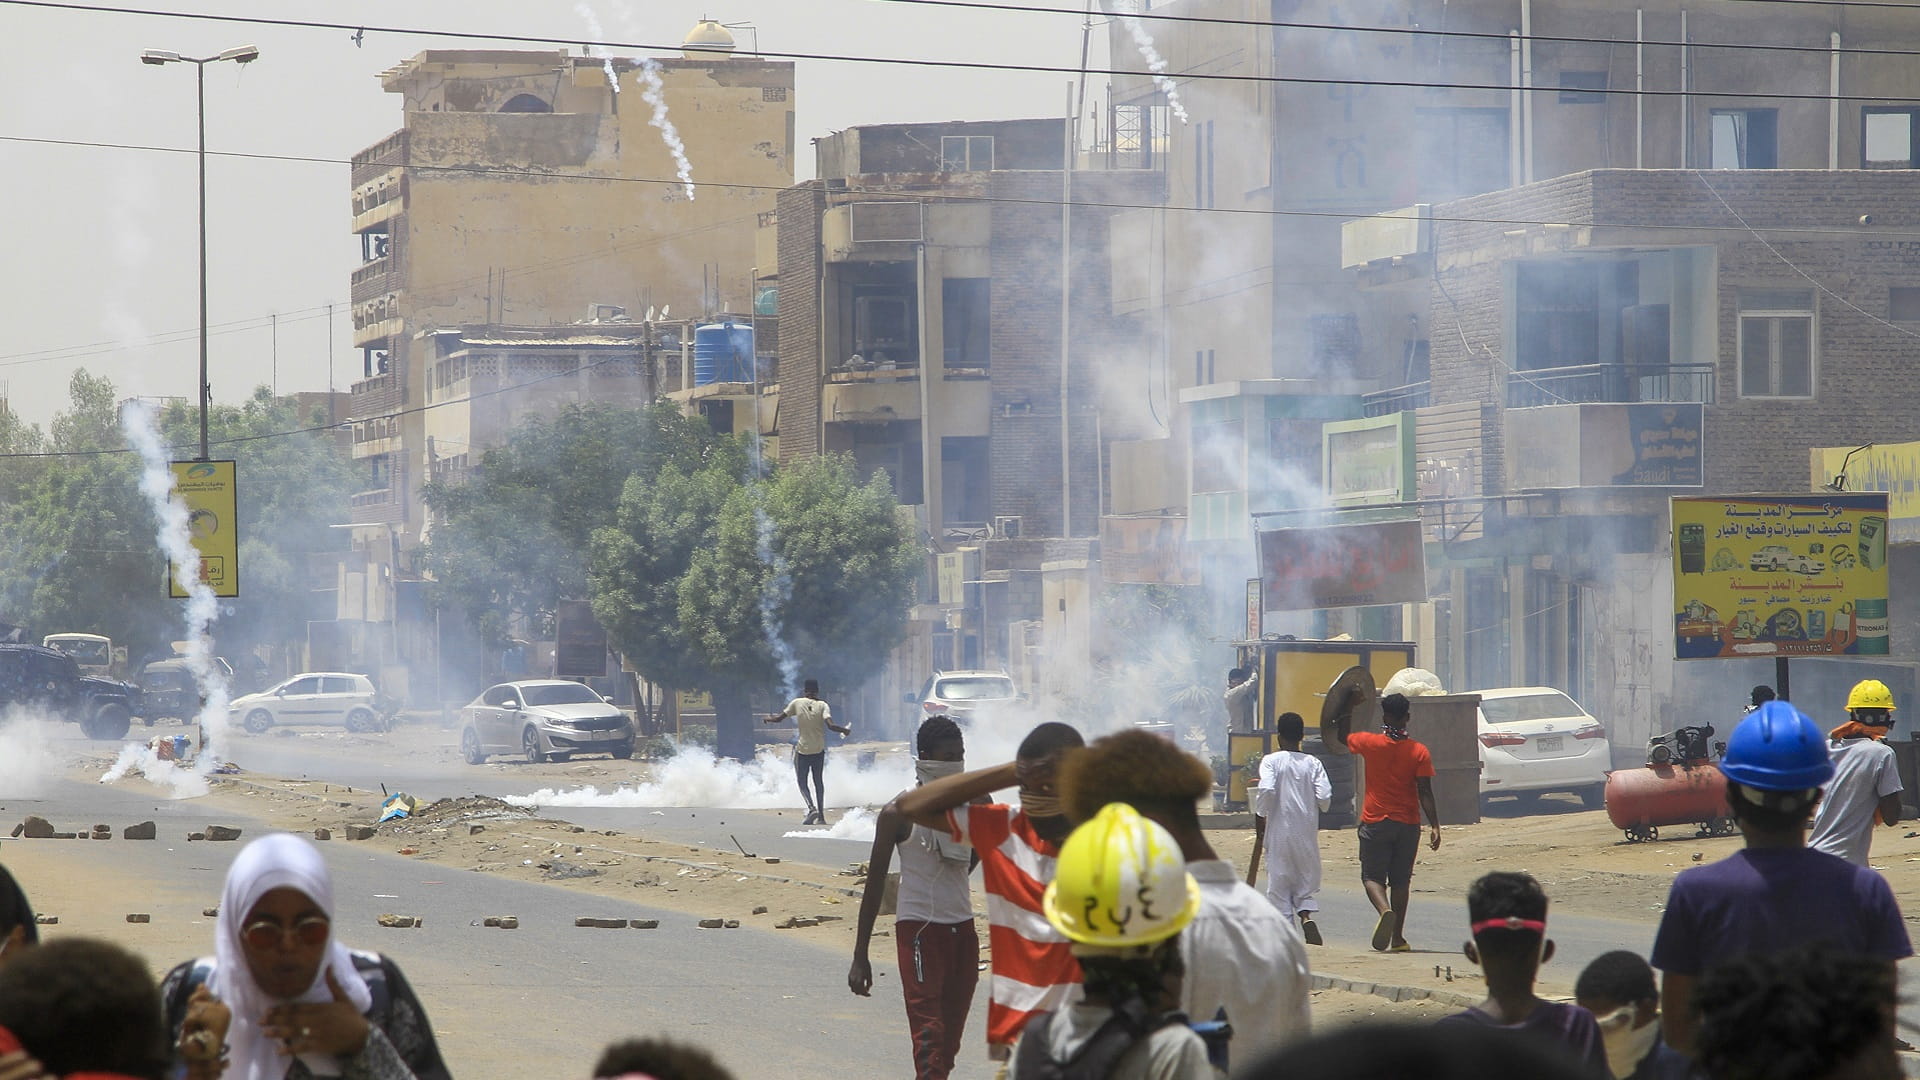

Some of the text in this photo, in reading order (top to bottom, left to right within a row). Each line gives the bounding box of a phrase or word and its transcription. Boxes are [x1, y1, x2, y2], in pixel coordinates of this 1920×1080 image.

[1633, 465, 1670, 482] Saudi
[1725, 503, 1842, 520] مركز المدينة
[1716, 522, 1742, 538] الغيار
[1774, 523, 1814, 537] السيارات
[1818, 522, 1852, 537] لتكييف
[1729, 575, 1843, 593] بنشر المدينة
